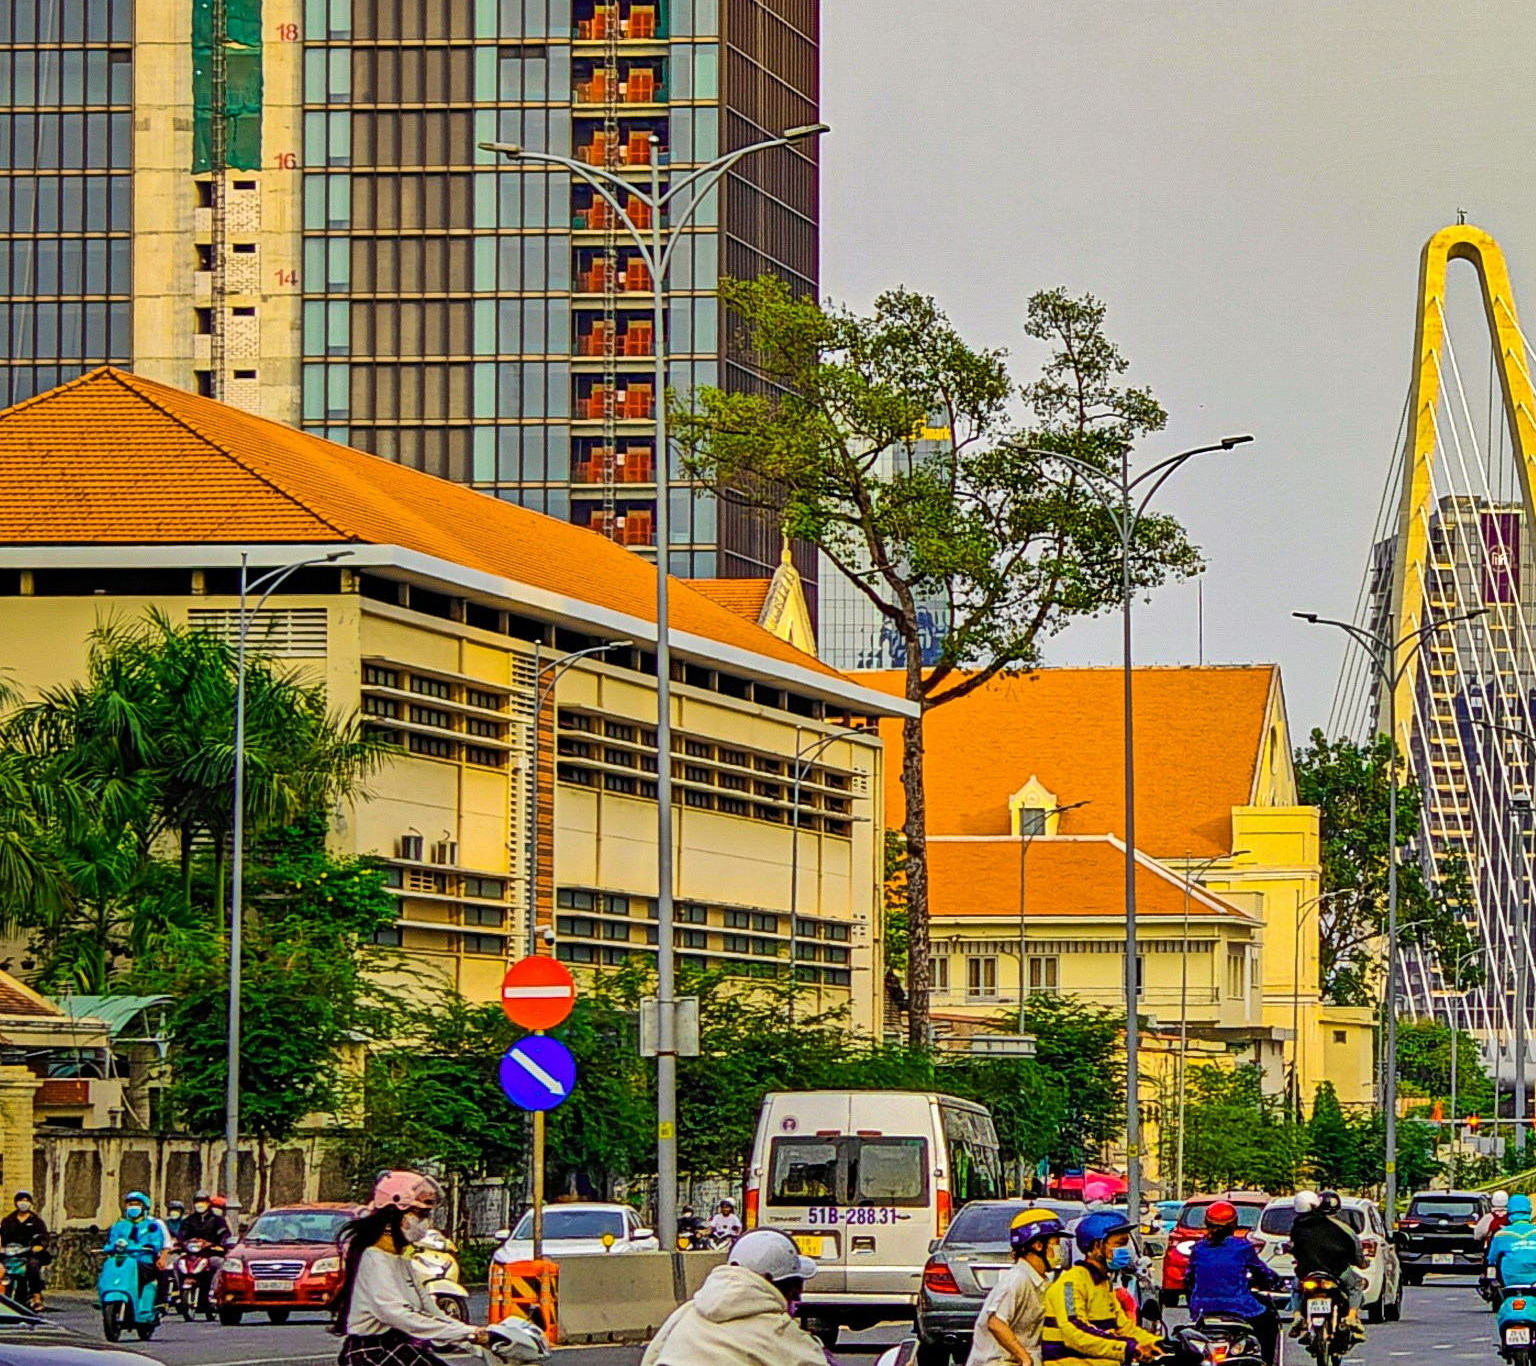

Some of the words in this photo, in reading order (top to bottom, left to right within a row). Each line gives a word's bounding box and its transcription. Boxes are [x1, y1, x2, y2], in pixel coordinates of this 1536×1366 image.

[275, 23, 299, 42] 18
[274, 152, 296, 170] 16
[274, 268, 298, 287] 14
[808, 1207, 897, 1225] 51B-288.31
